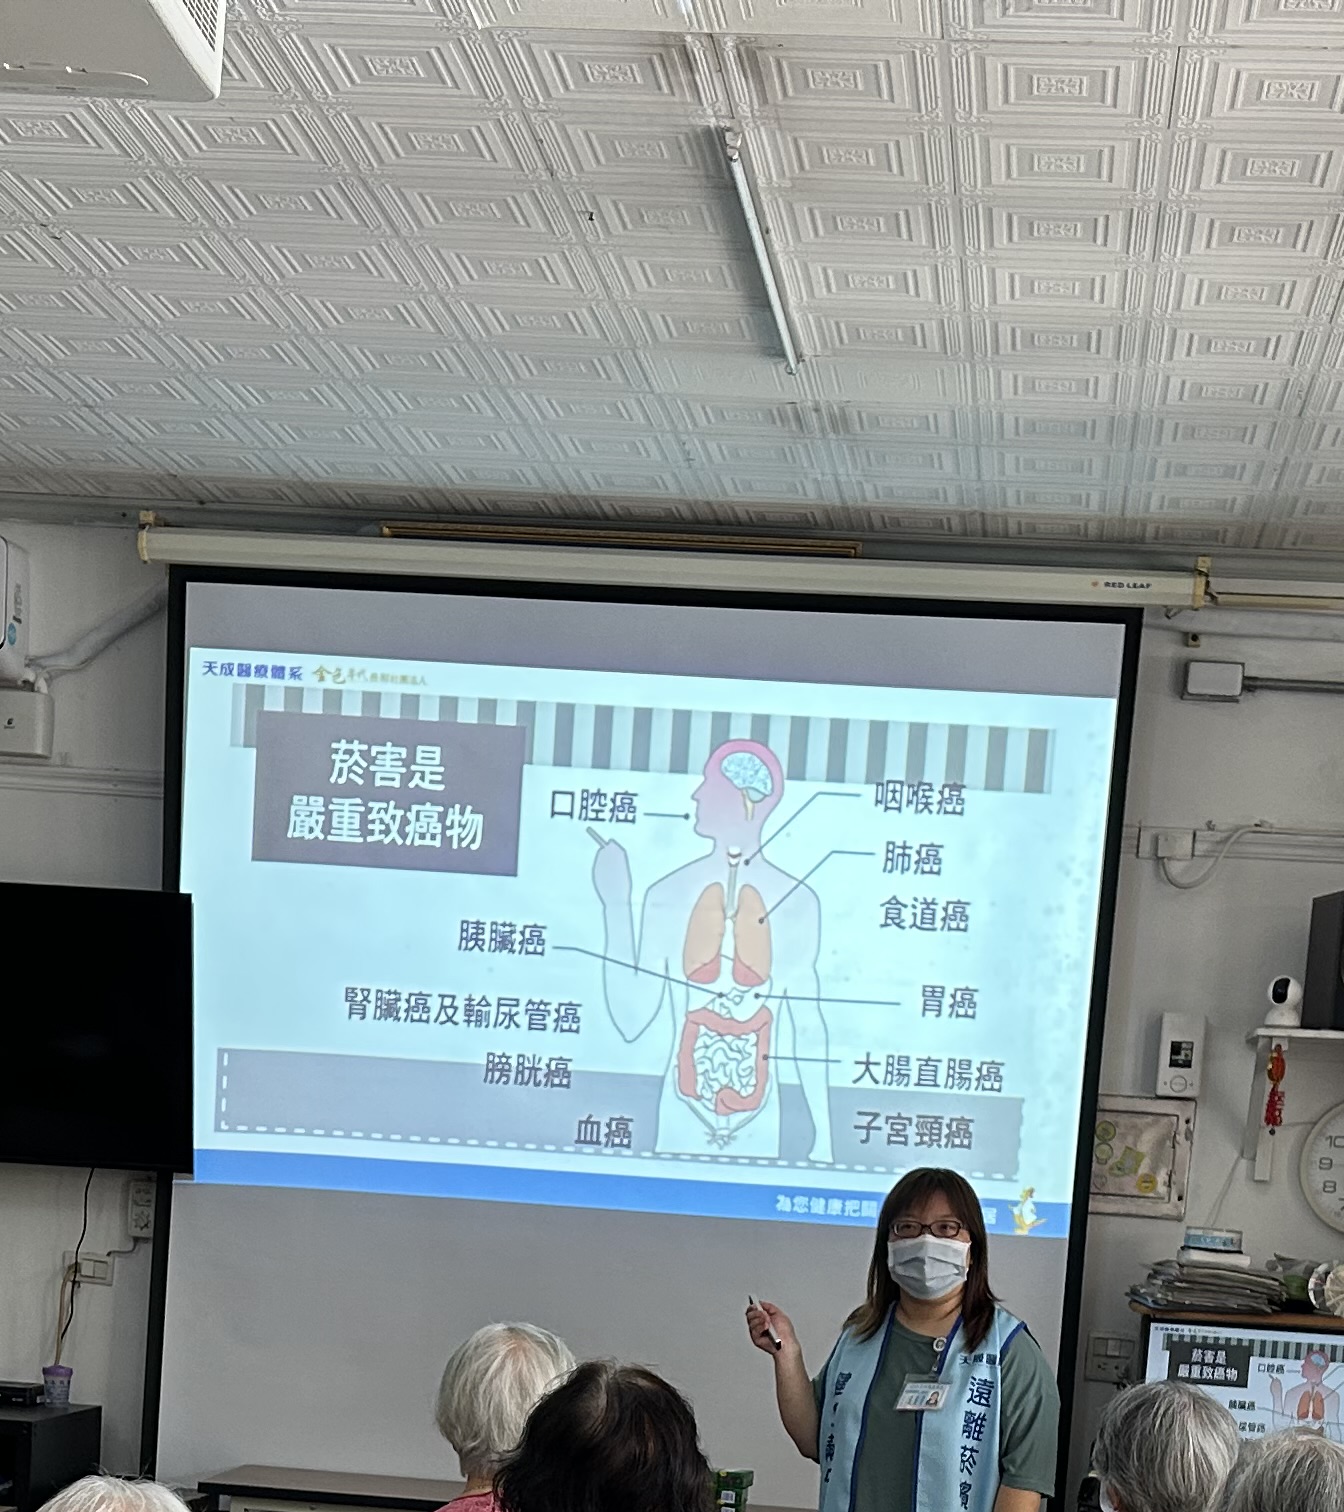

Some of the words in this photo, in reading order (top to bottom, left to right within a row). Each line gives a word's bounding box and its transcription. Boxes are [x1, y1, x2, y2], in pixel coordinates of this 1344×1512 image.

[329, 738, 446, 792] 菸害是
[550, 787, 638, 827] 口腔癌
[874, 778, 966, 817] 咽喉癌
[286, 795, 485, 851] 嚴重致癌物
[882, 840, 945, 878] 肺癌
[878, 896, 971, 935] 食道癌
[458, 919, 548, 958] 胰臟癌
[344, 986, 583, 1035] 腎臟癌及輸尿管癌
[920, 982, 978, 1020] 胃癌
[484, 1051, 573, 1090] 膀胱癌
[853, 1052, 1004, 1094] 大腸直腸癌
[576, 1114, 633, 1151] 血癌
[854, 1111, 975, 1152] 子宮頸癌
[1319, 1157, 1333, 1170] 9
[1323, 1181, 1337, 1193] 8
